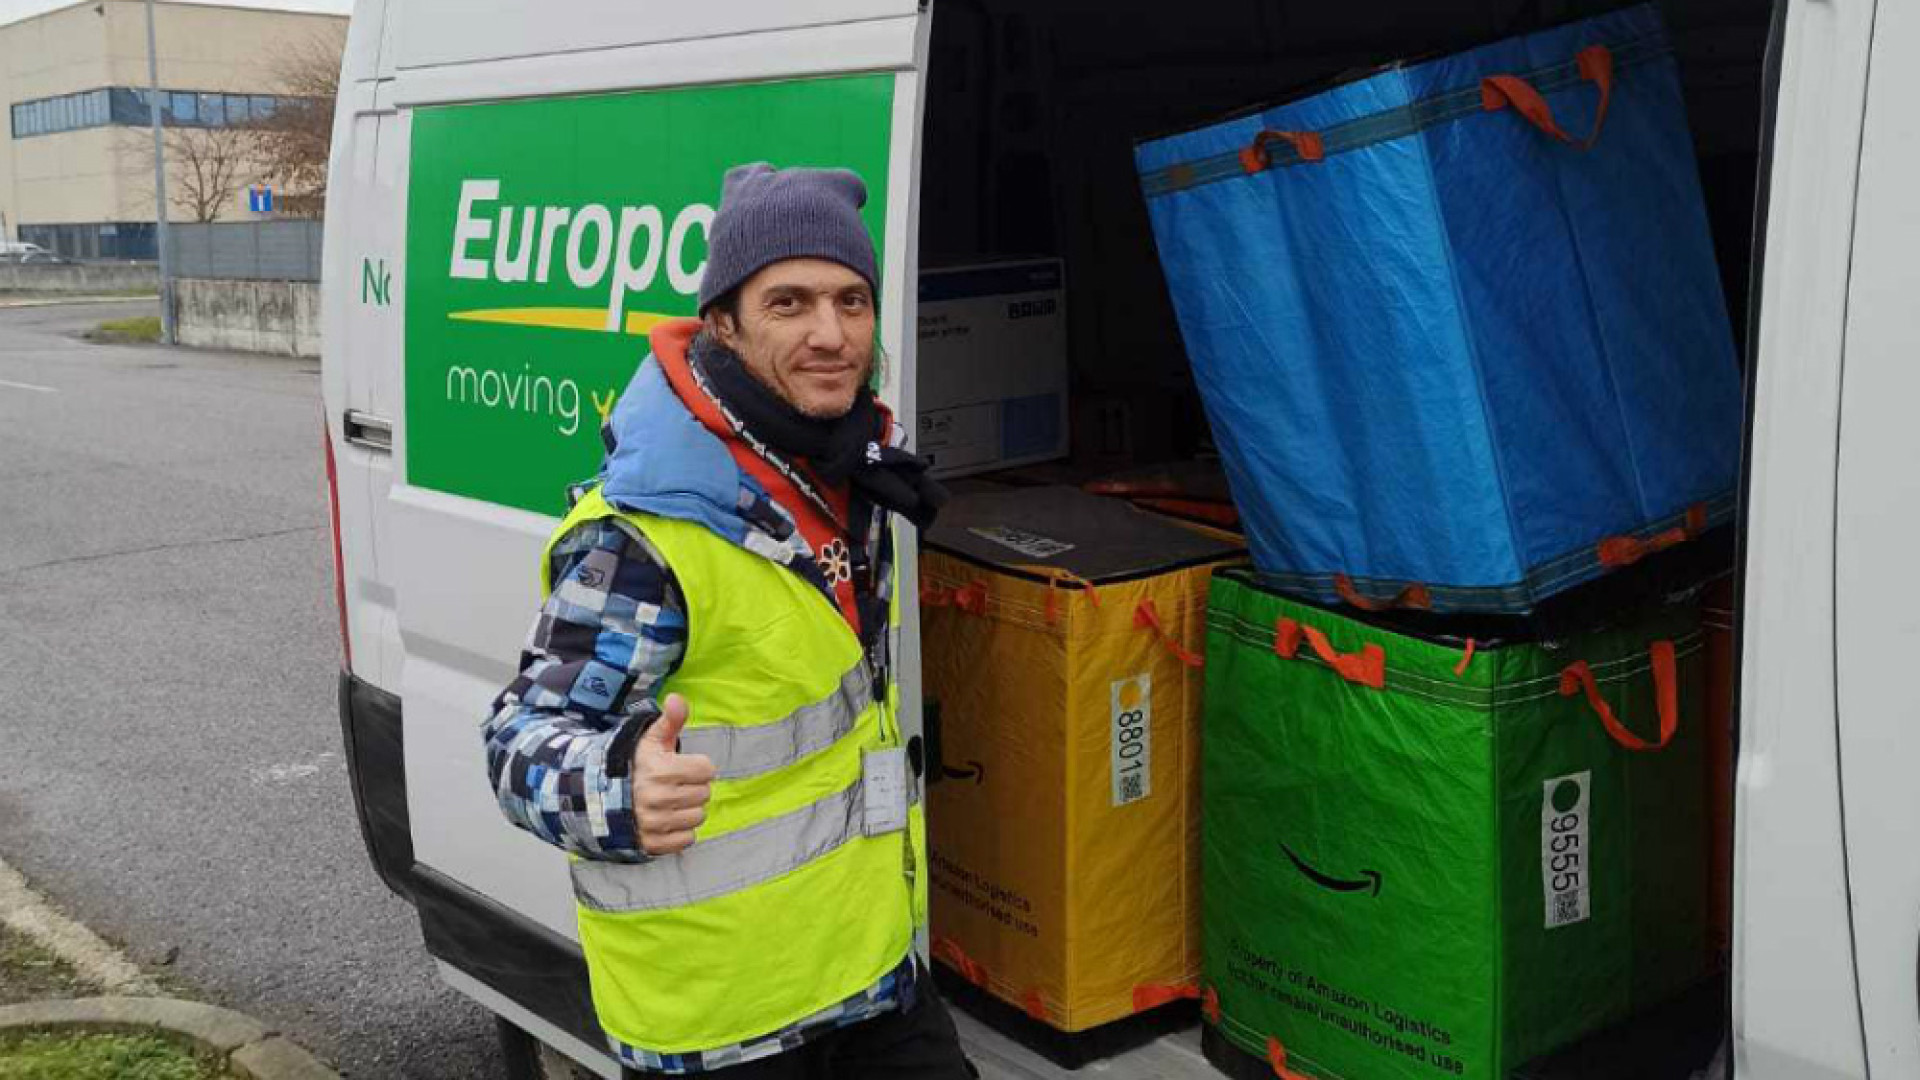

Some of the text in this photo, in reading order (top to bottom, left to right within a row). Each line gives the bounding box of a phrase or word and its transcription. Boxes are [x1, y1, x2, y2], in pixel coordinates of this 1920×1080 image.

[448, 178, 718, 333] Europc
[446, 361, 580, 435] moving
[1119, 710, 1143, 774] 8801
[1551, 813, 1579, 891] 9555
[1230, 937, 1283, 982] Property
[1306, 975, 1370, 1014] Amazon
[1374, 1001, 1452, 1046] Logistics
[1431, 1053, 1464, 1076] use
